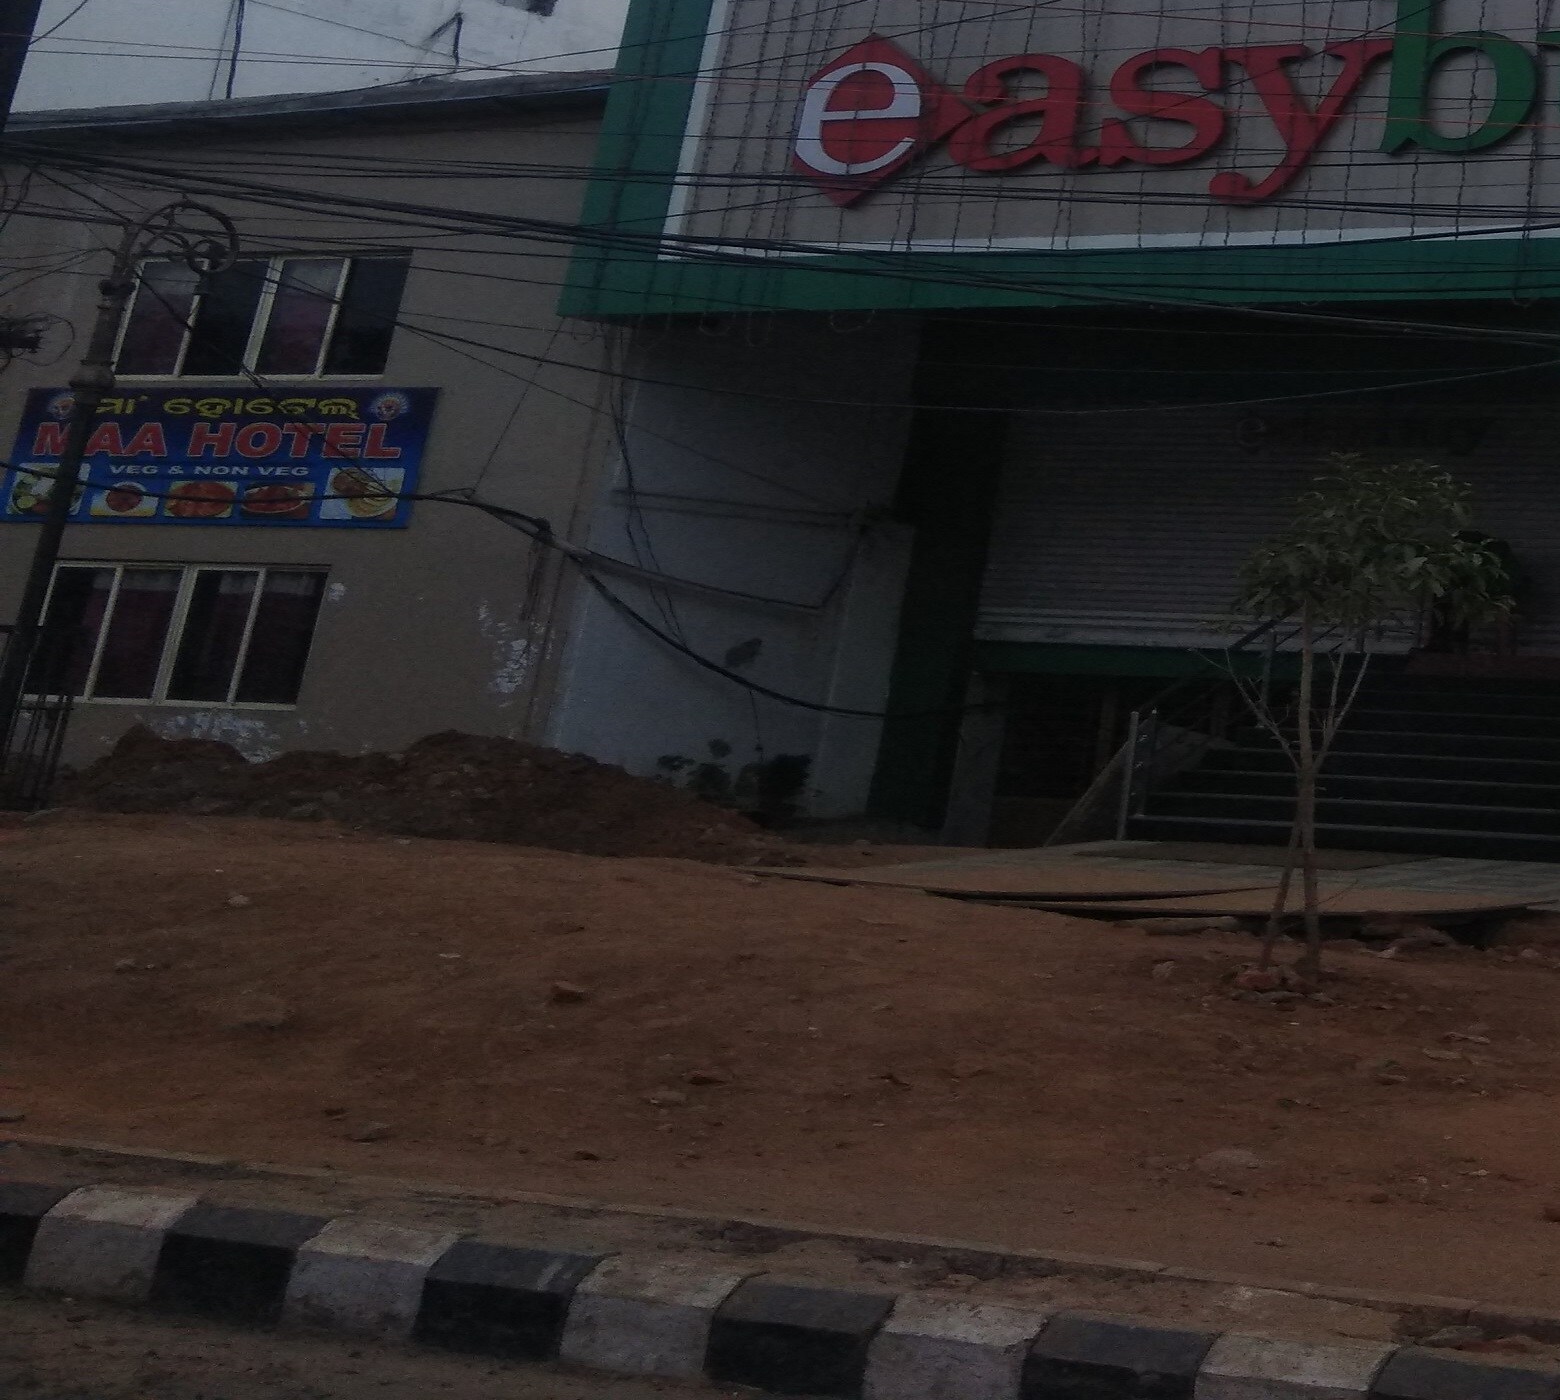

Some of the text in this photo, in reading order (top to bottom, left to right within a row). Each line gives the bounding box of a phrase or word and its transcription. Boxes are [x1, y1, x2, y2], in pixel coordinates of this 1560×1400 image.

[188, 422, 402, 460] HOTEL
[109, 464, 310, 478] VEG & NON VEG
